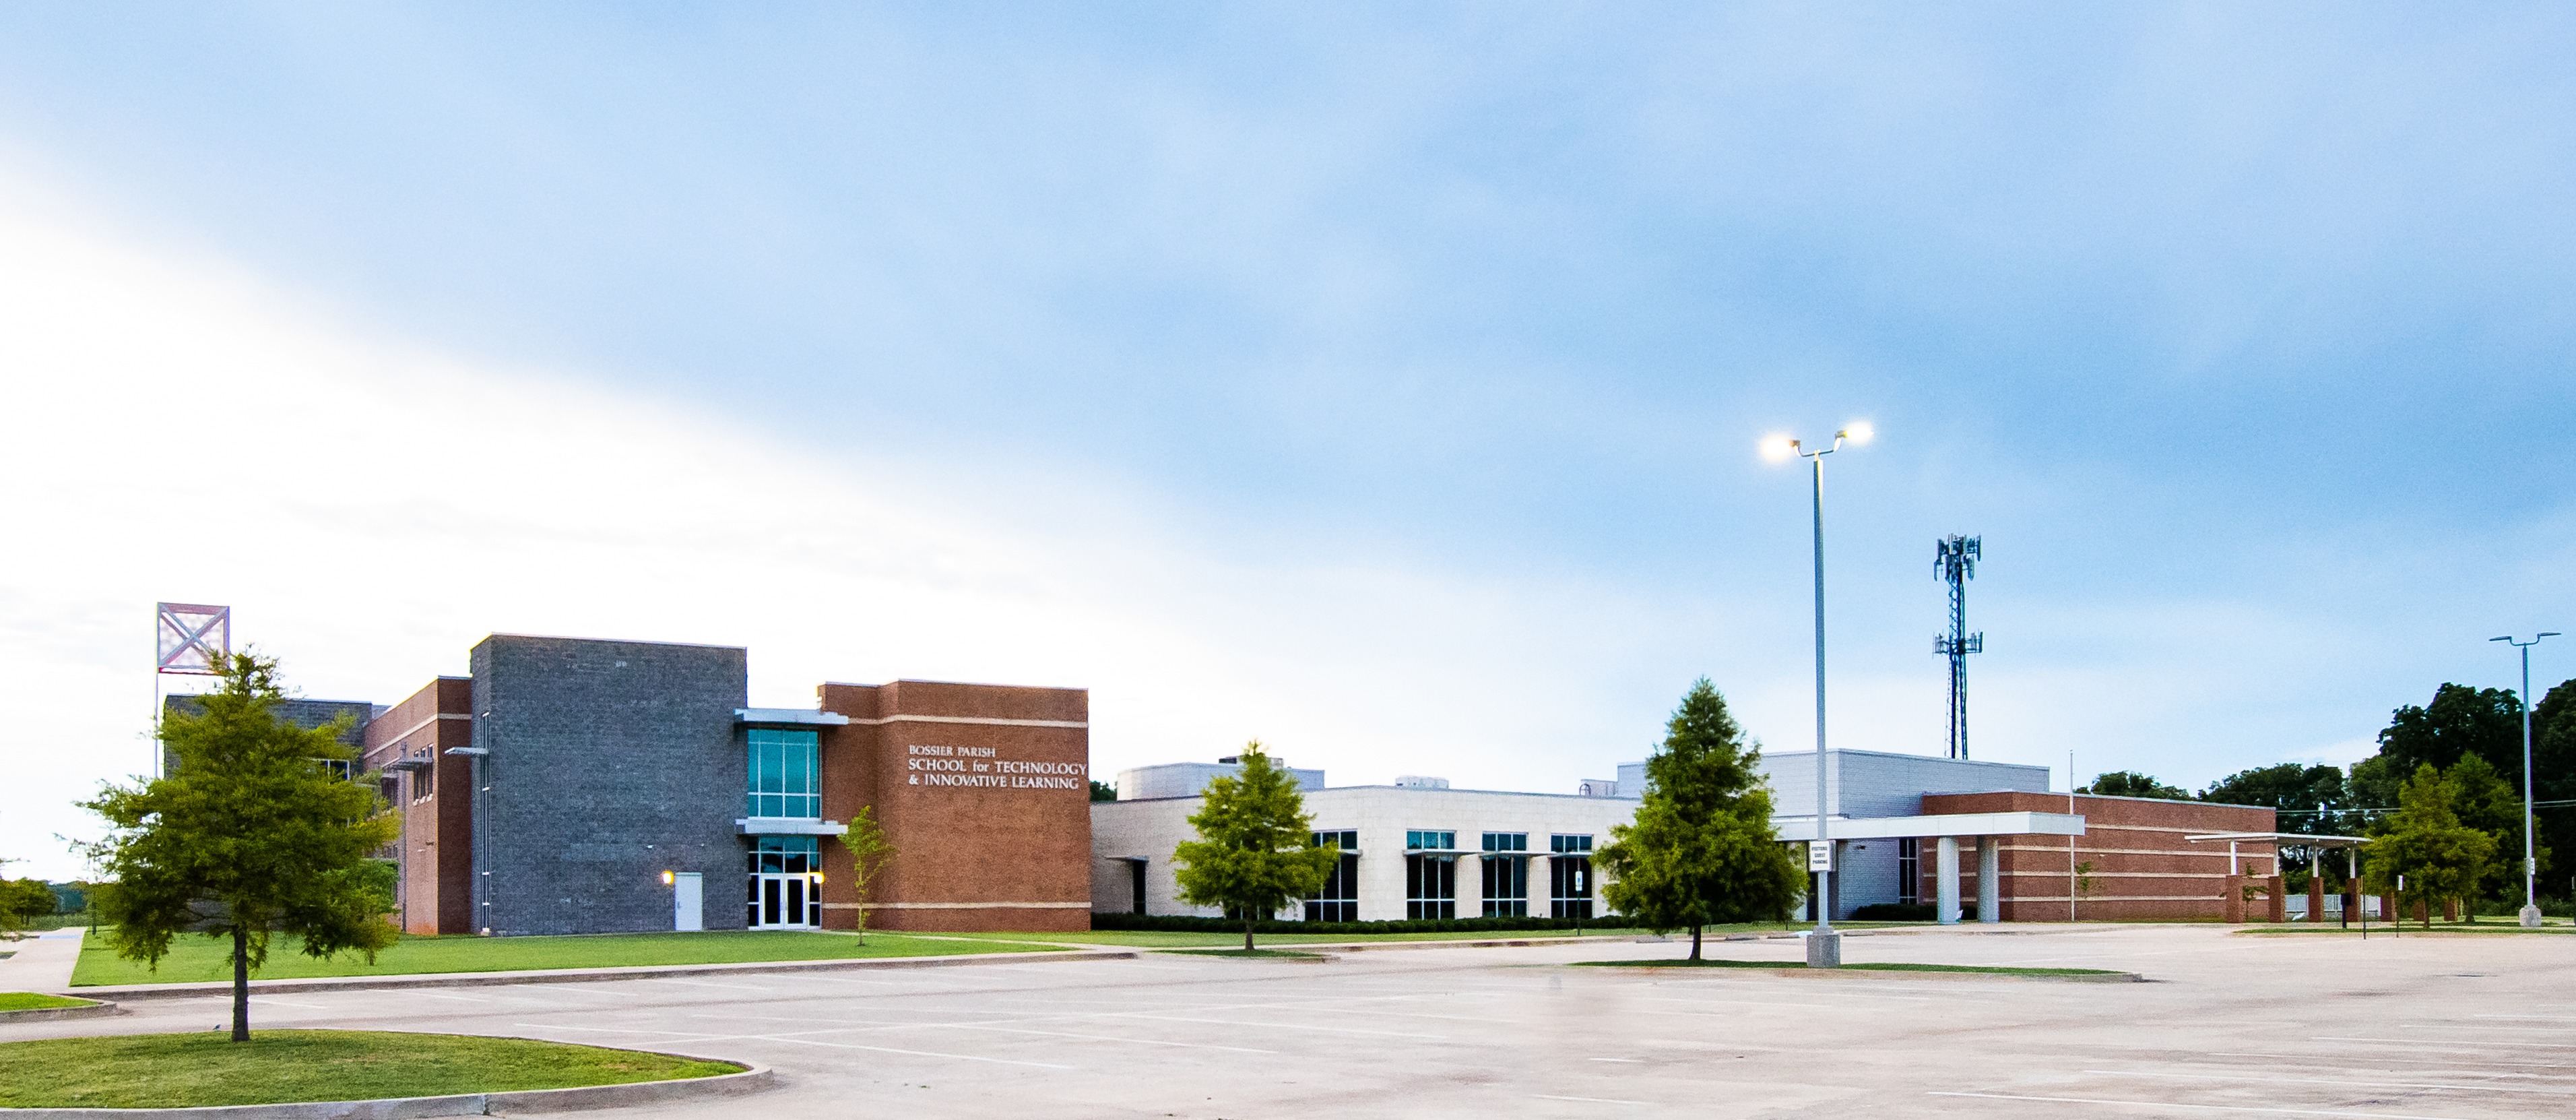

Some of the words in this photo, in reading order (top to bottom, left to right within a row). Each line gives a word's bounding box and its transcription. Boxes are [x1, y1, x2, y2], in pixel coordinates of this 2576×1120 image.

[909, 745, 953, 756] BOSSIER
[957, 746, 996, 757] PARISH
[908, 757, 967, 772] SCHOOL
[972, 759, 989, 772] for
[994, 761, 1087, 776] TECHNOLOGY
[908, 774, 919, 786] &
[924, 774, 1008, 788] INNOVATIVE
[1011, 776, 1078, 790] LEARNING
